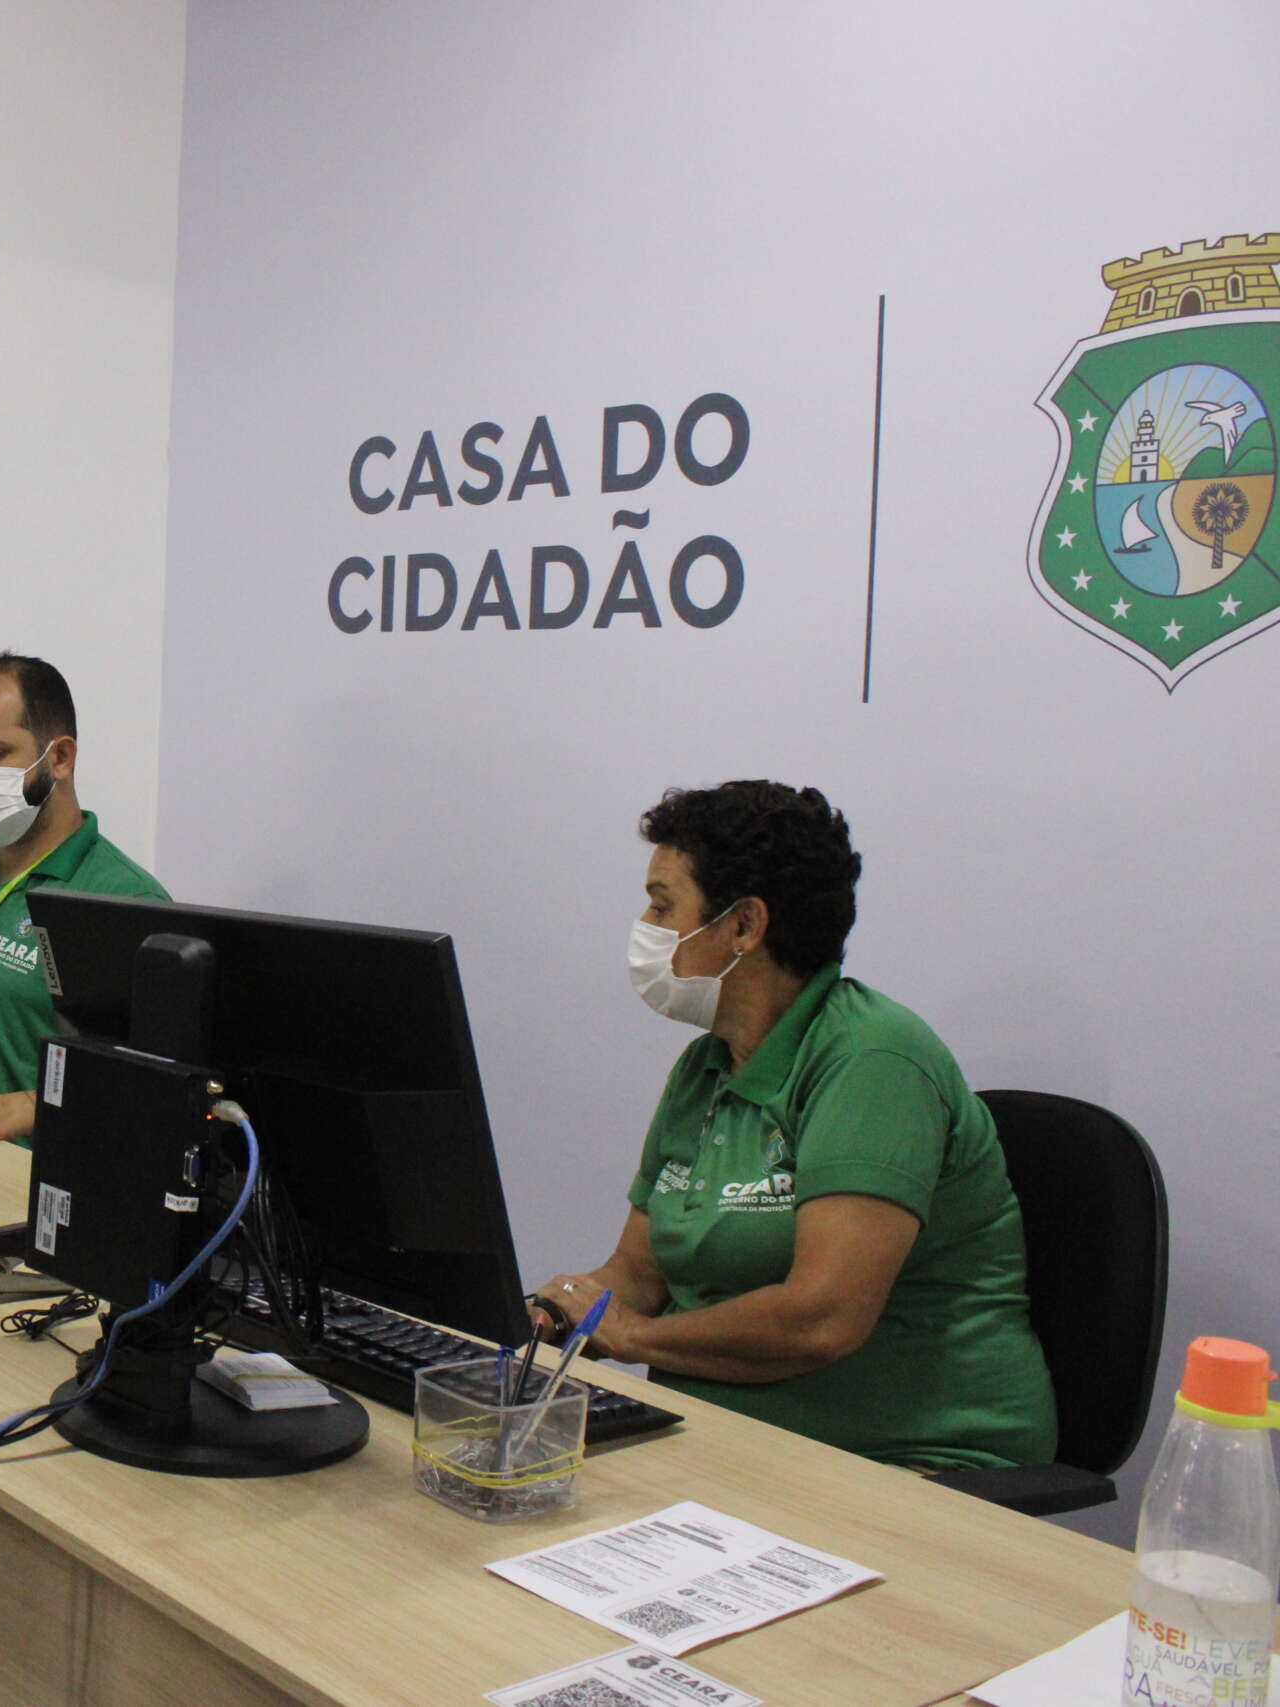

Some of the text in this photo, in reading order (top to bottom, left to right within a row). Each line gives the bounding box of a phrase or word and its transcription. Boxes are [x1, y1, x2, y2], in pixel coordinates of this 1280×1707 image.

[348, 392, 750, 515] CASA DO
[327, 508, 745, 634] CIDADÃO
[39, 932, 59, 990] Lenovo
[760, 1195, 777, 1204] DO
[658, 1666, 734, 1703] CEARÁ
